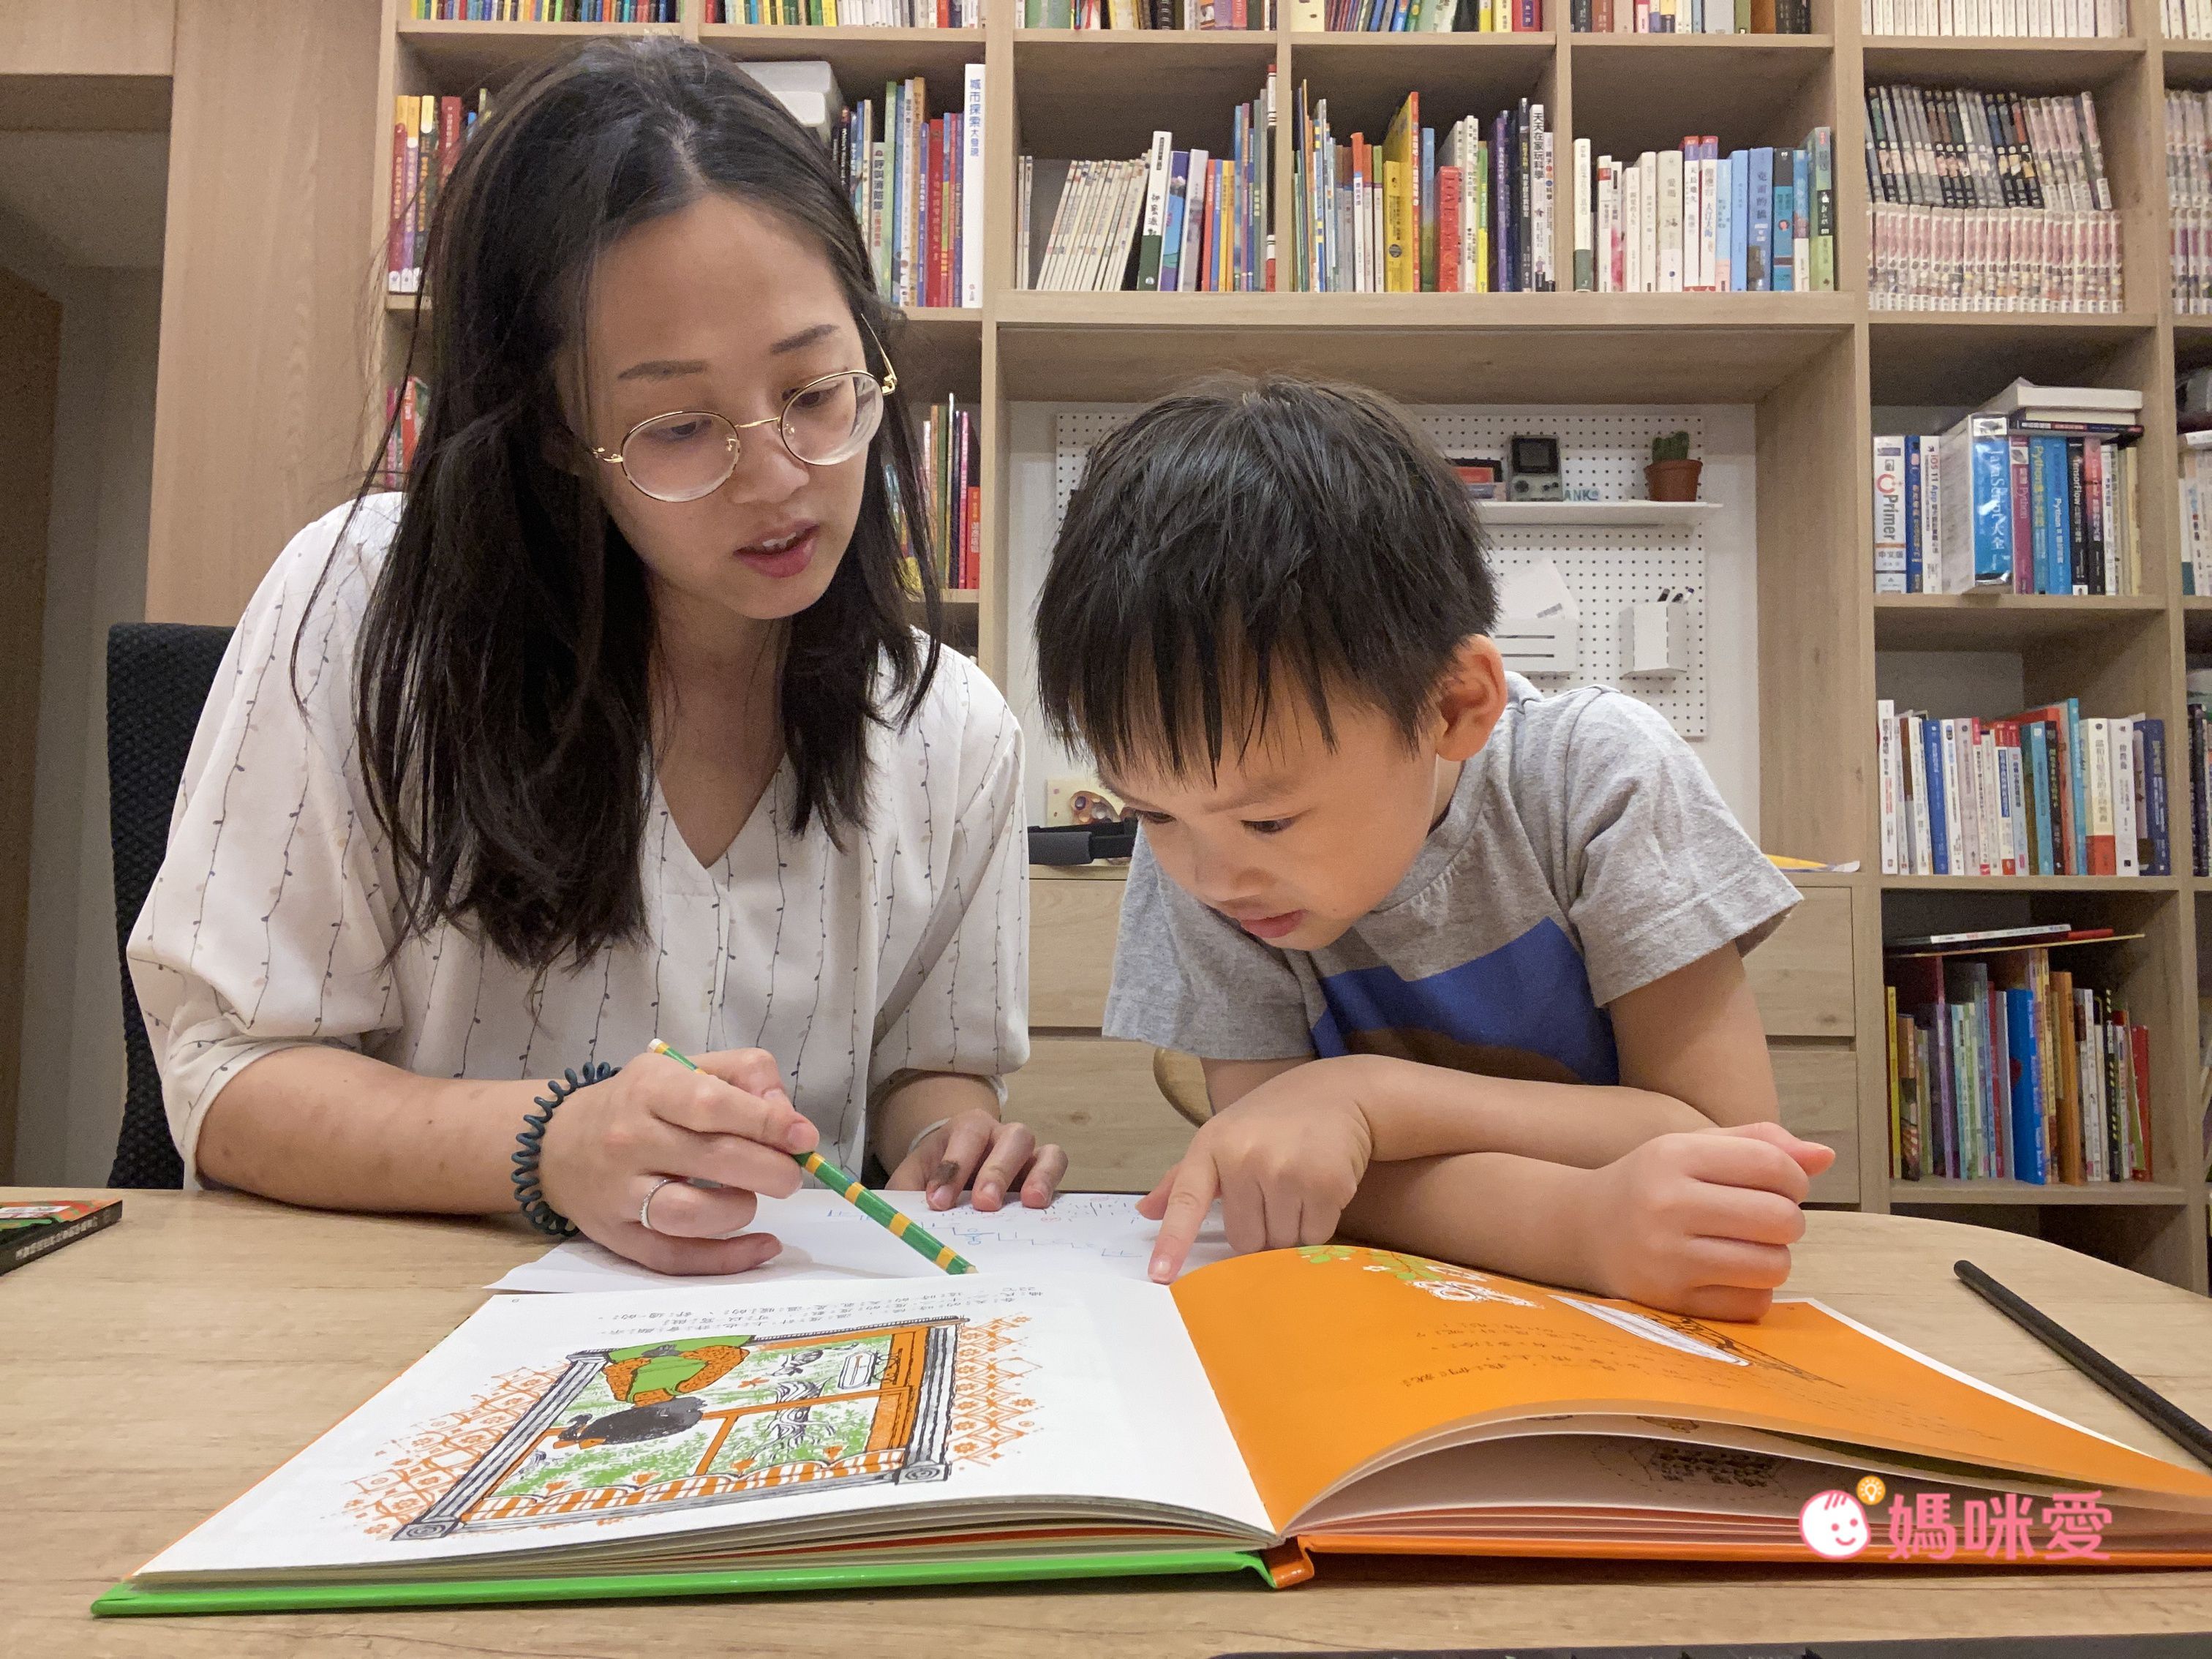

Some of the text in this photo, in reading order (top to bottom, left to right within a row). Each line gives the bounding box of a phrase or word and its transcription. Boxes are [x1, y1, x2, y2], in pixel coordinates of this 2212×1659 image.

[1533, 112, 1544, 180] 天天在家玩科學
[1930, 484, 1938, 503] App
[2072, 457, 2083, 505] TensorFlow
[1882, 494, 1899, 541] Primer
[2017, 486, 2030, 519] Python
[2052, 497, 2063, 527] Python
